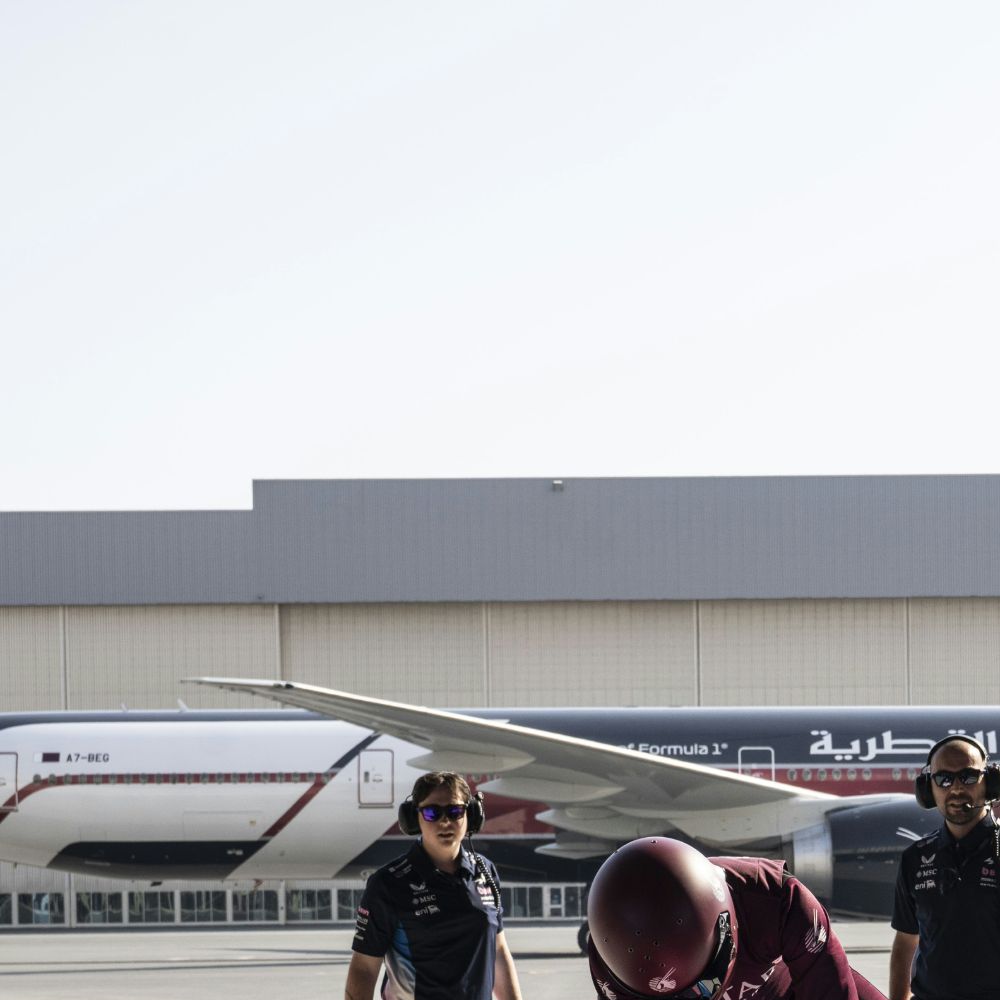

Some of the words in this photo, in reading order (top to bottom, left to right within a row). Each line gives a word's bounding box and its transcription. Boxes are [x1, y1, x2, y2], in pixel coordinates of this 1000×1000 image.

[638, 743, 709, 756] Formula
[810, 729, 998, 761] الطرية
[66, 753, 110, 763] A7-BEG
